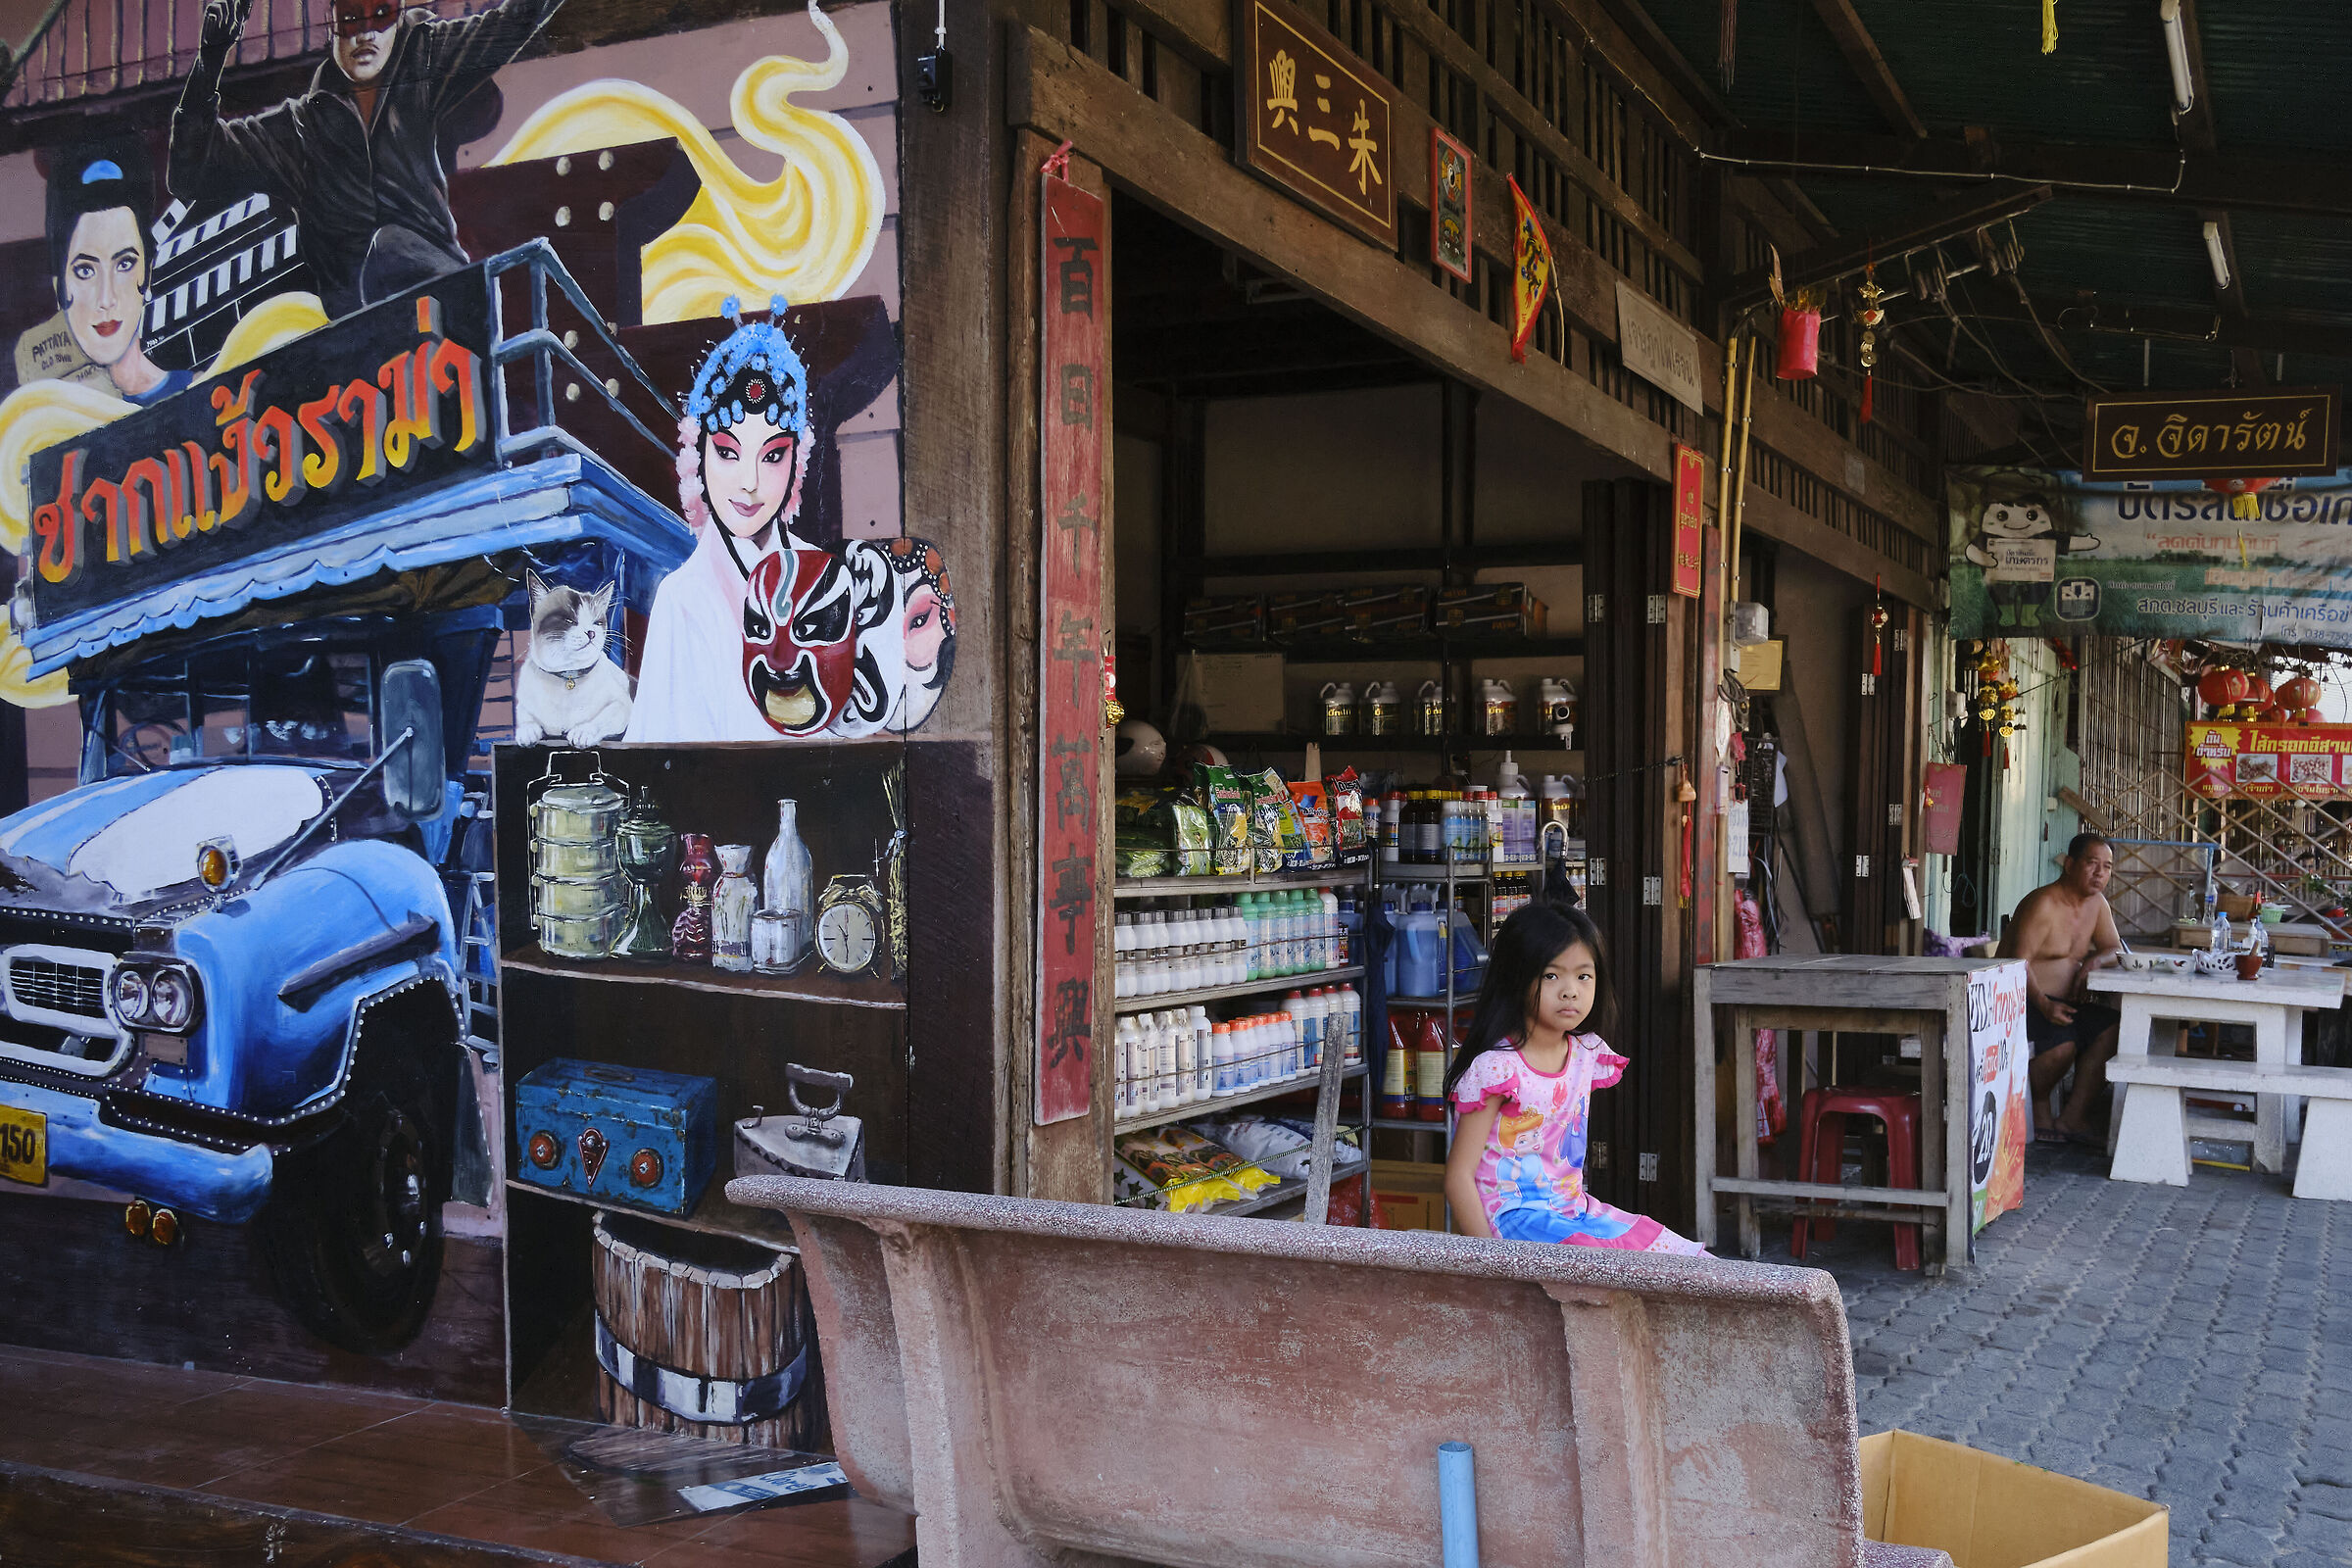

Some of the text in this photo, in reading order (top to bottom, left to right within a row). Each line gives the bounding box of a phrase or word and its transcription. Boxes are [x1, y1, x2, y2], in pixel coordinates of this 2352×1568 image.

[32, 331, 72, 363] PATTAYA
[2249, 730, 2352, 754] ไส้กรอกอีสาน
